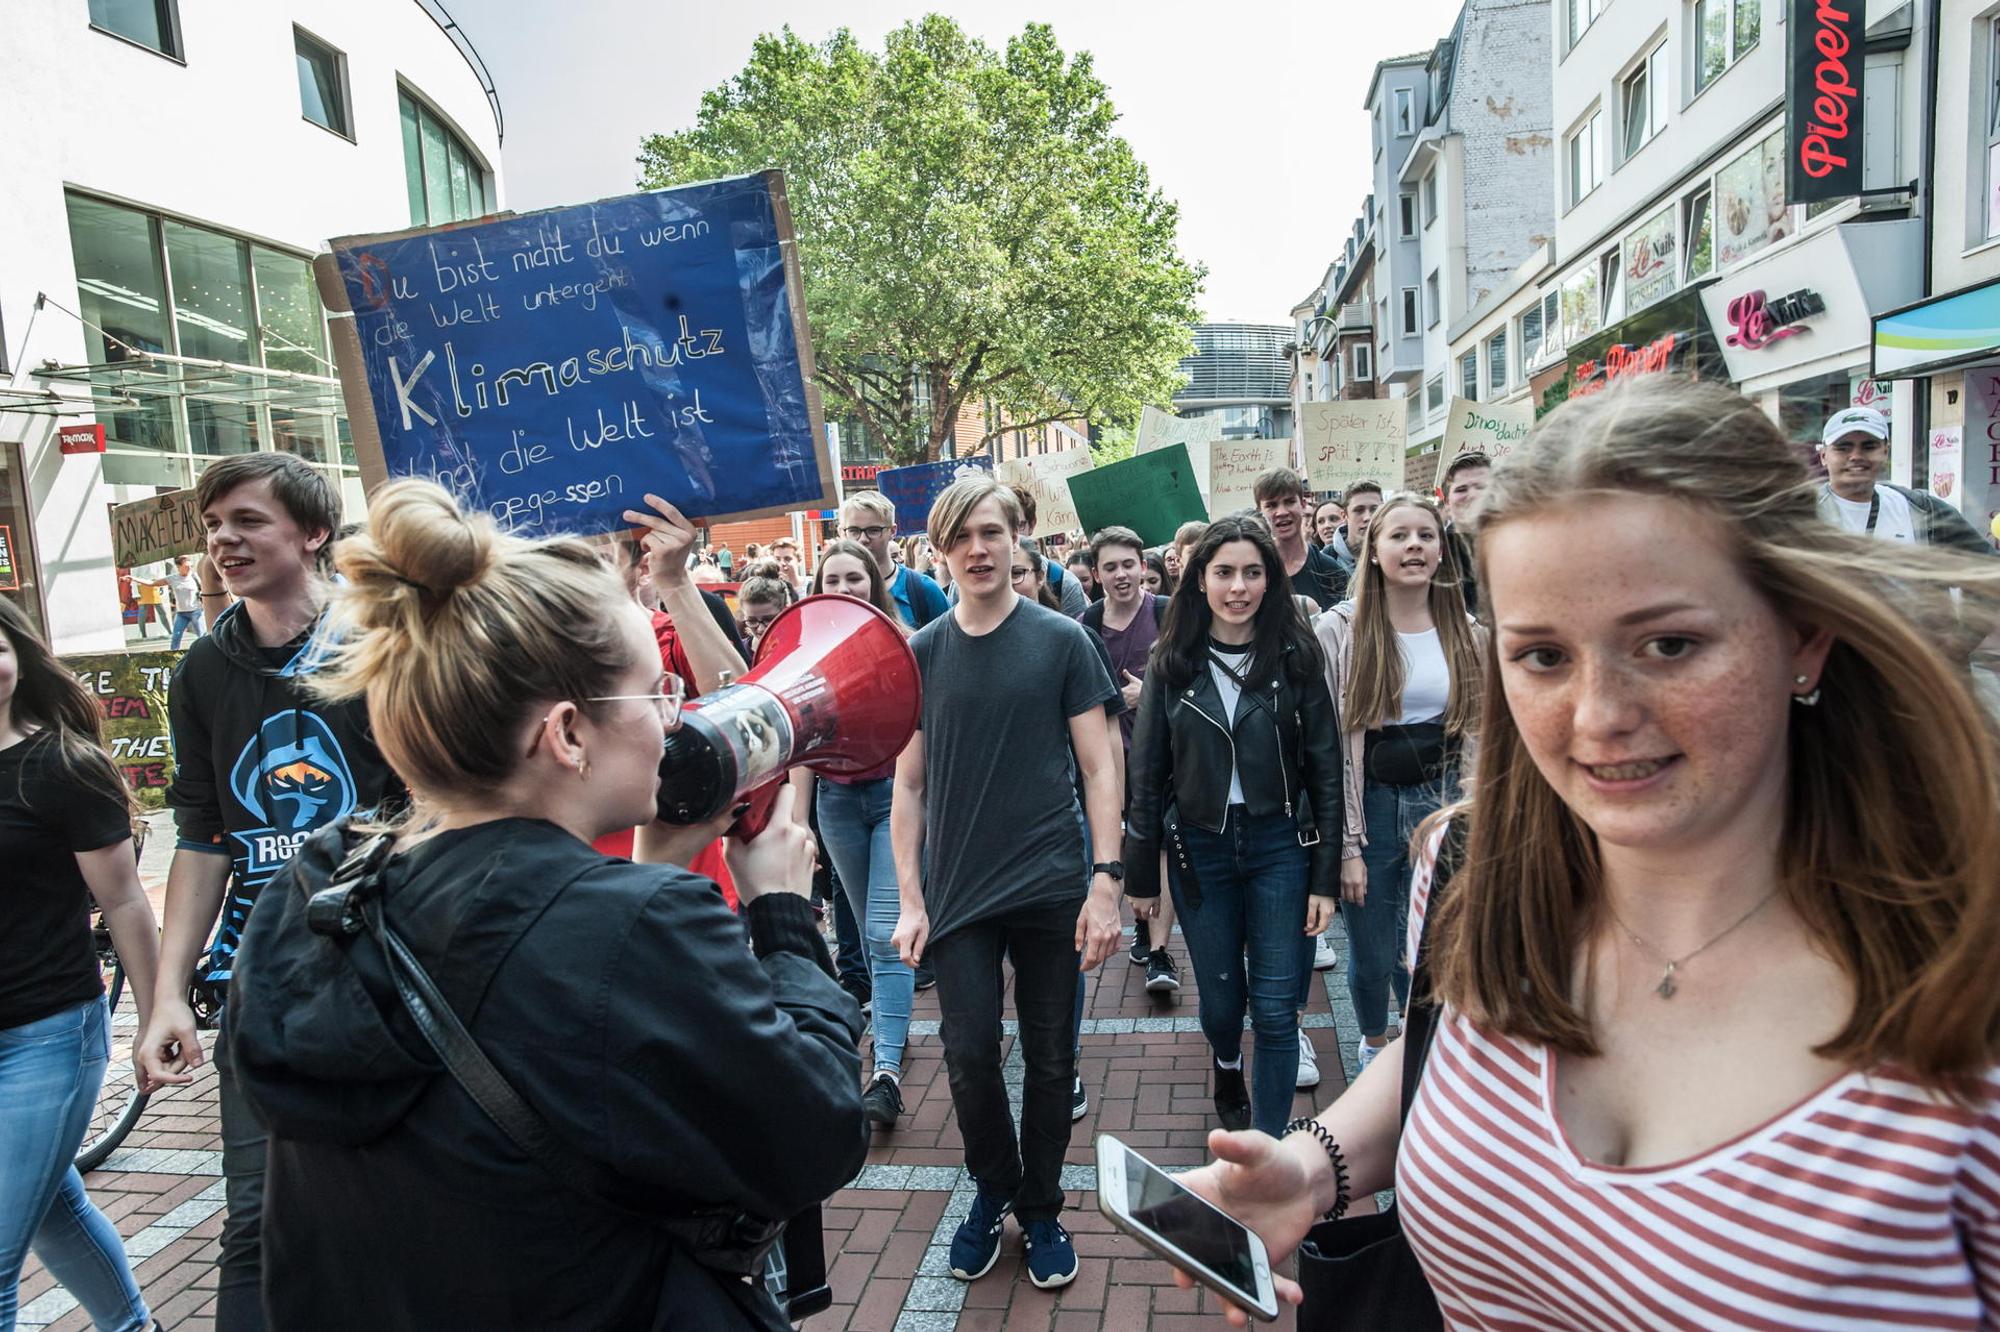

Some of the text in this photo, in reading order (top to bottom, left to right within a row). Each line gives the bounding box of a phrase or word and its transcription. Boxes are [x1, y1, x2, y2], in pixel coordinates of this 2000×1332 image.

[1801, 0, 1857, 178] Pieper
[428, 237, 500, 293] bist
[511, 225, 575, 273] nicht
[586, 218, 625, 258] du
[640, 219, 711, 249] wenn
[1652, 231, 1675, 259] Nails
[374, 269, 630, 347] die Welt untergeht
[388, 314, 726, 431] Klimaschutz
[1875, 381, 1892, 396] Nail
[500, 430, 554, 475] die
[567, 400, 655, 451] Welt
[667, 388, 714, 428] ist
[1317, 409, 1369, 441] Später
[1464, 411, 1499, 432] Dinos
[1215, 448, 1275, 463] The Earth is
[1490, 443, 1511, 457] Sie
[489, 473, 624, 531] gegessen
[117, 509, 168, 562] MAKE
[79, 670, 116, 694] GE
[100, 696, 150, 719] TEM
[111, 736, 171, 759] THE
[121, 763, 169, 788] TE
